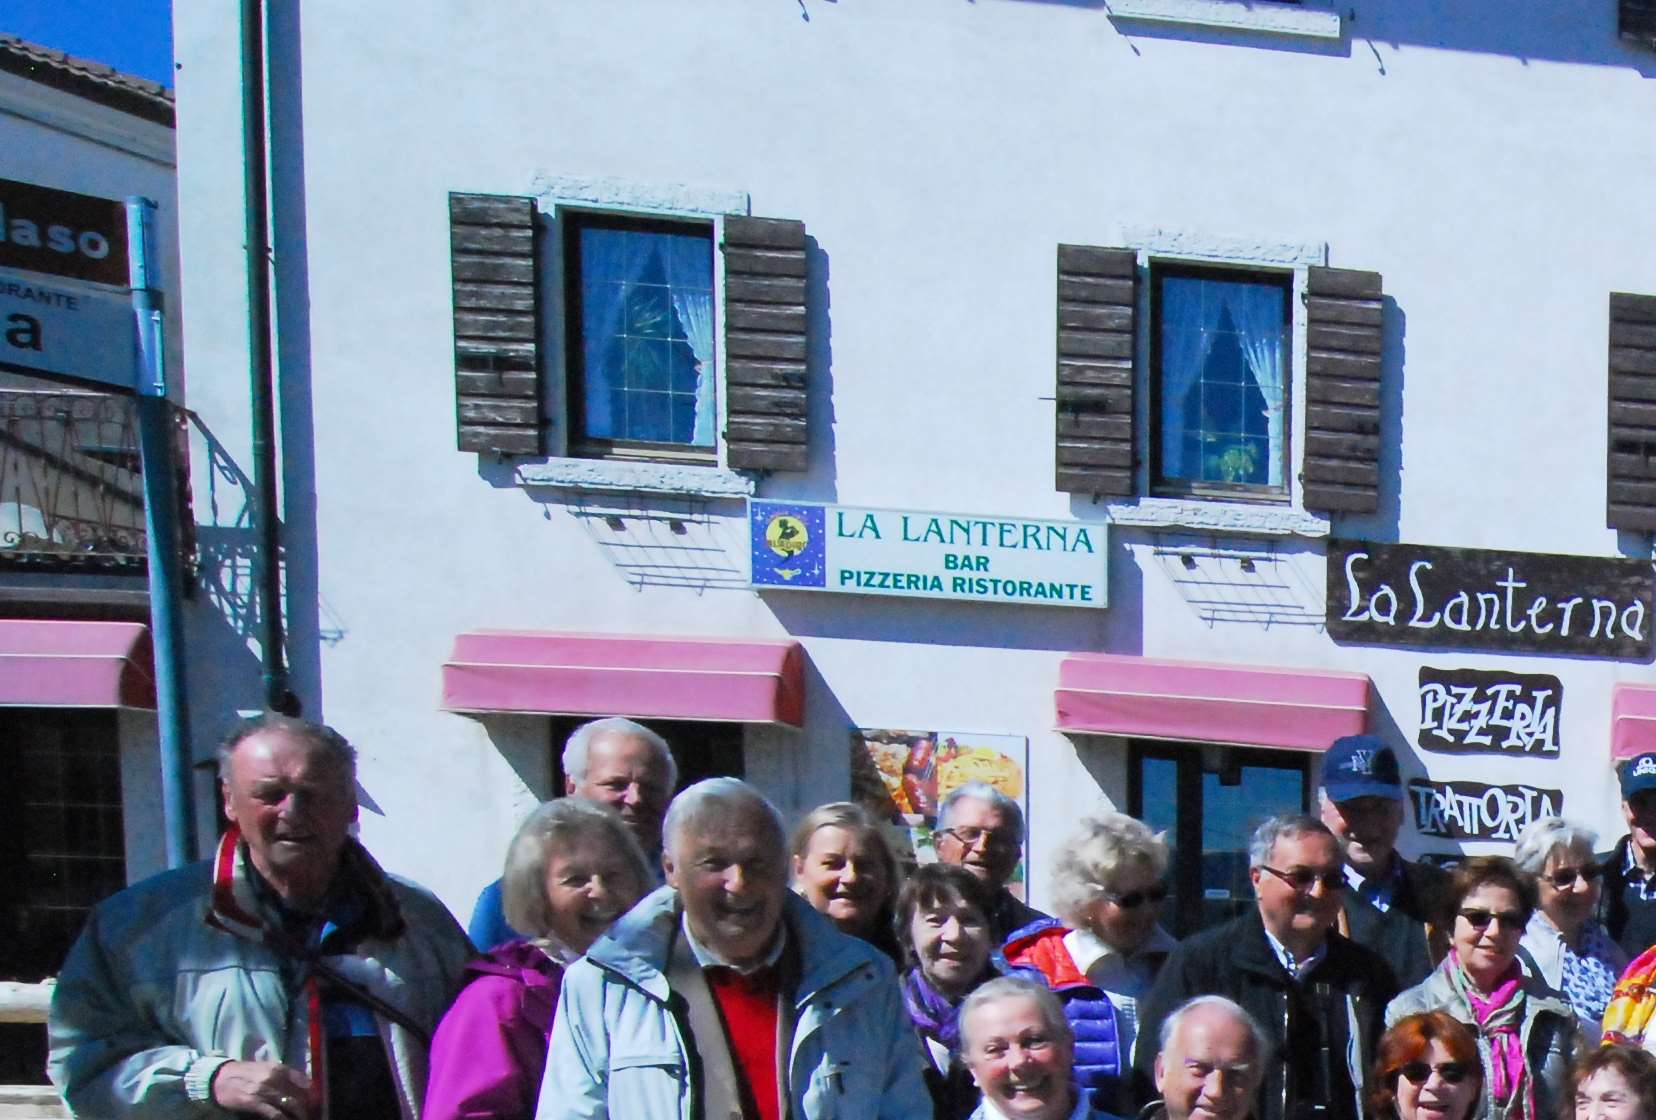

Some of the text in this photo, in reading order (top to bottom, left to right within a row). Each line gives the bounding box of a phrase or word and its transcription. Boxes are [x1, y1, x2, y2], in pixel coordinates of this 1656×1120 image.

[836, 511, 1095, 553] LA LANTERNA
[944, 553, 990, 572] BAR
[839, 569, 1093, 601] PIZZERIA RISTORANTE
[1342, 553, 1644, 641] La Lanterna
[1420, 683, 1559, 751] PIZZERIA
